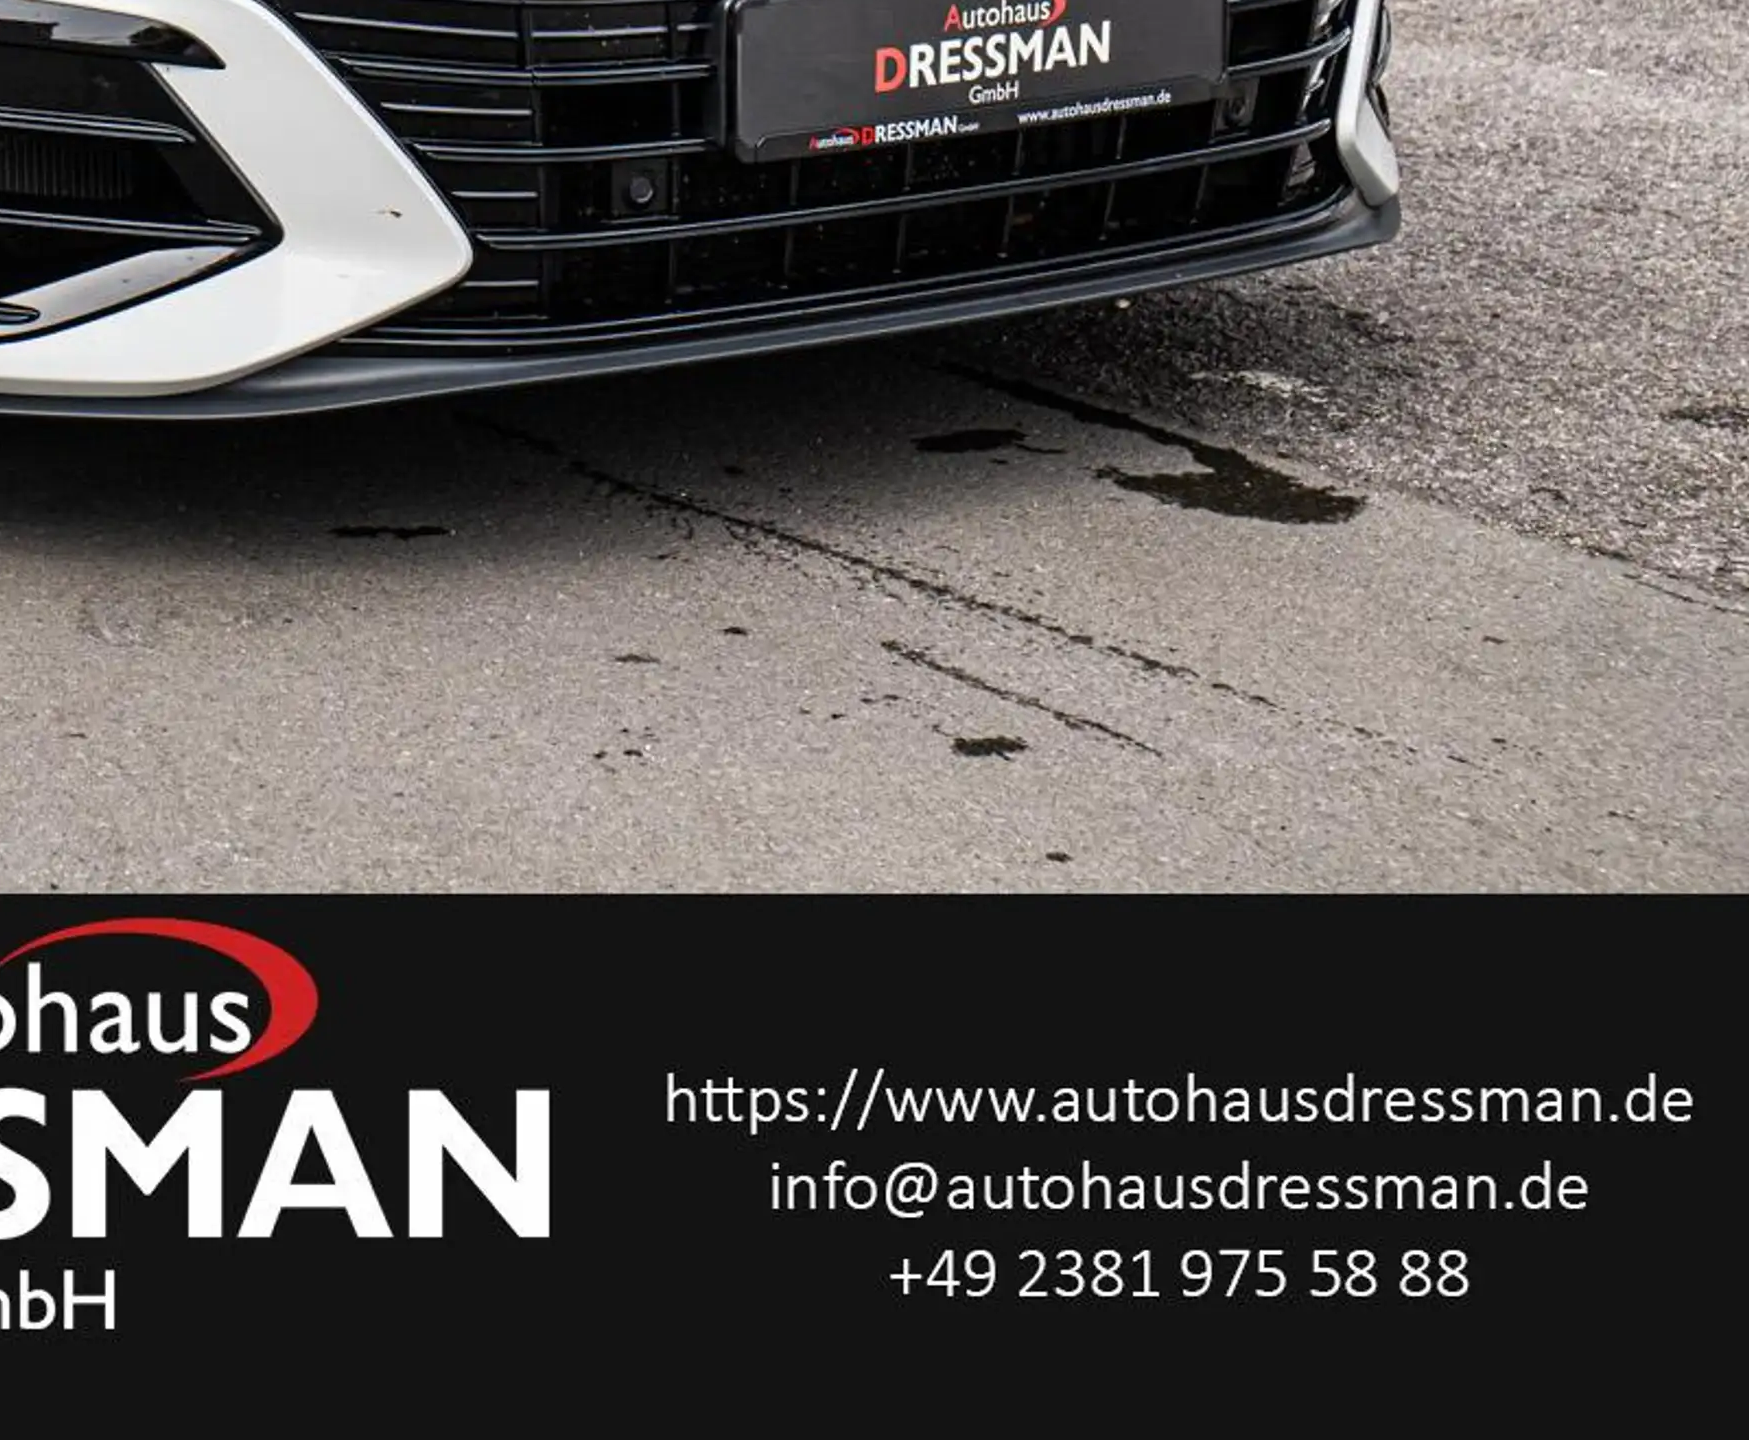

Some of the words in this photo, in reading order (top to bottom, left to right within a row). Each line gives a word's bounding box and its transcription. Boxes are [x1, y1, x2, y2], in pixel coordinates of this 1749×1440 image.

[874, 20, 1111, 93] DRESSMAN
[968, 80, 1021, 106] GmbH
[1017, 90, 1172, 124] www.autohausdressman.de
[862, 114, 959, 147] DRESSMAN
